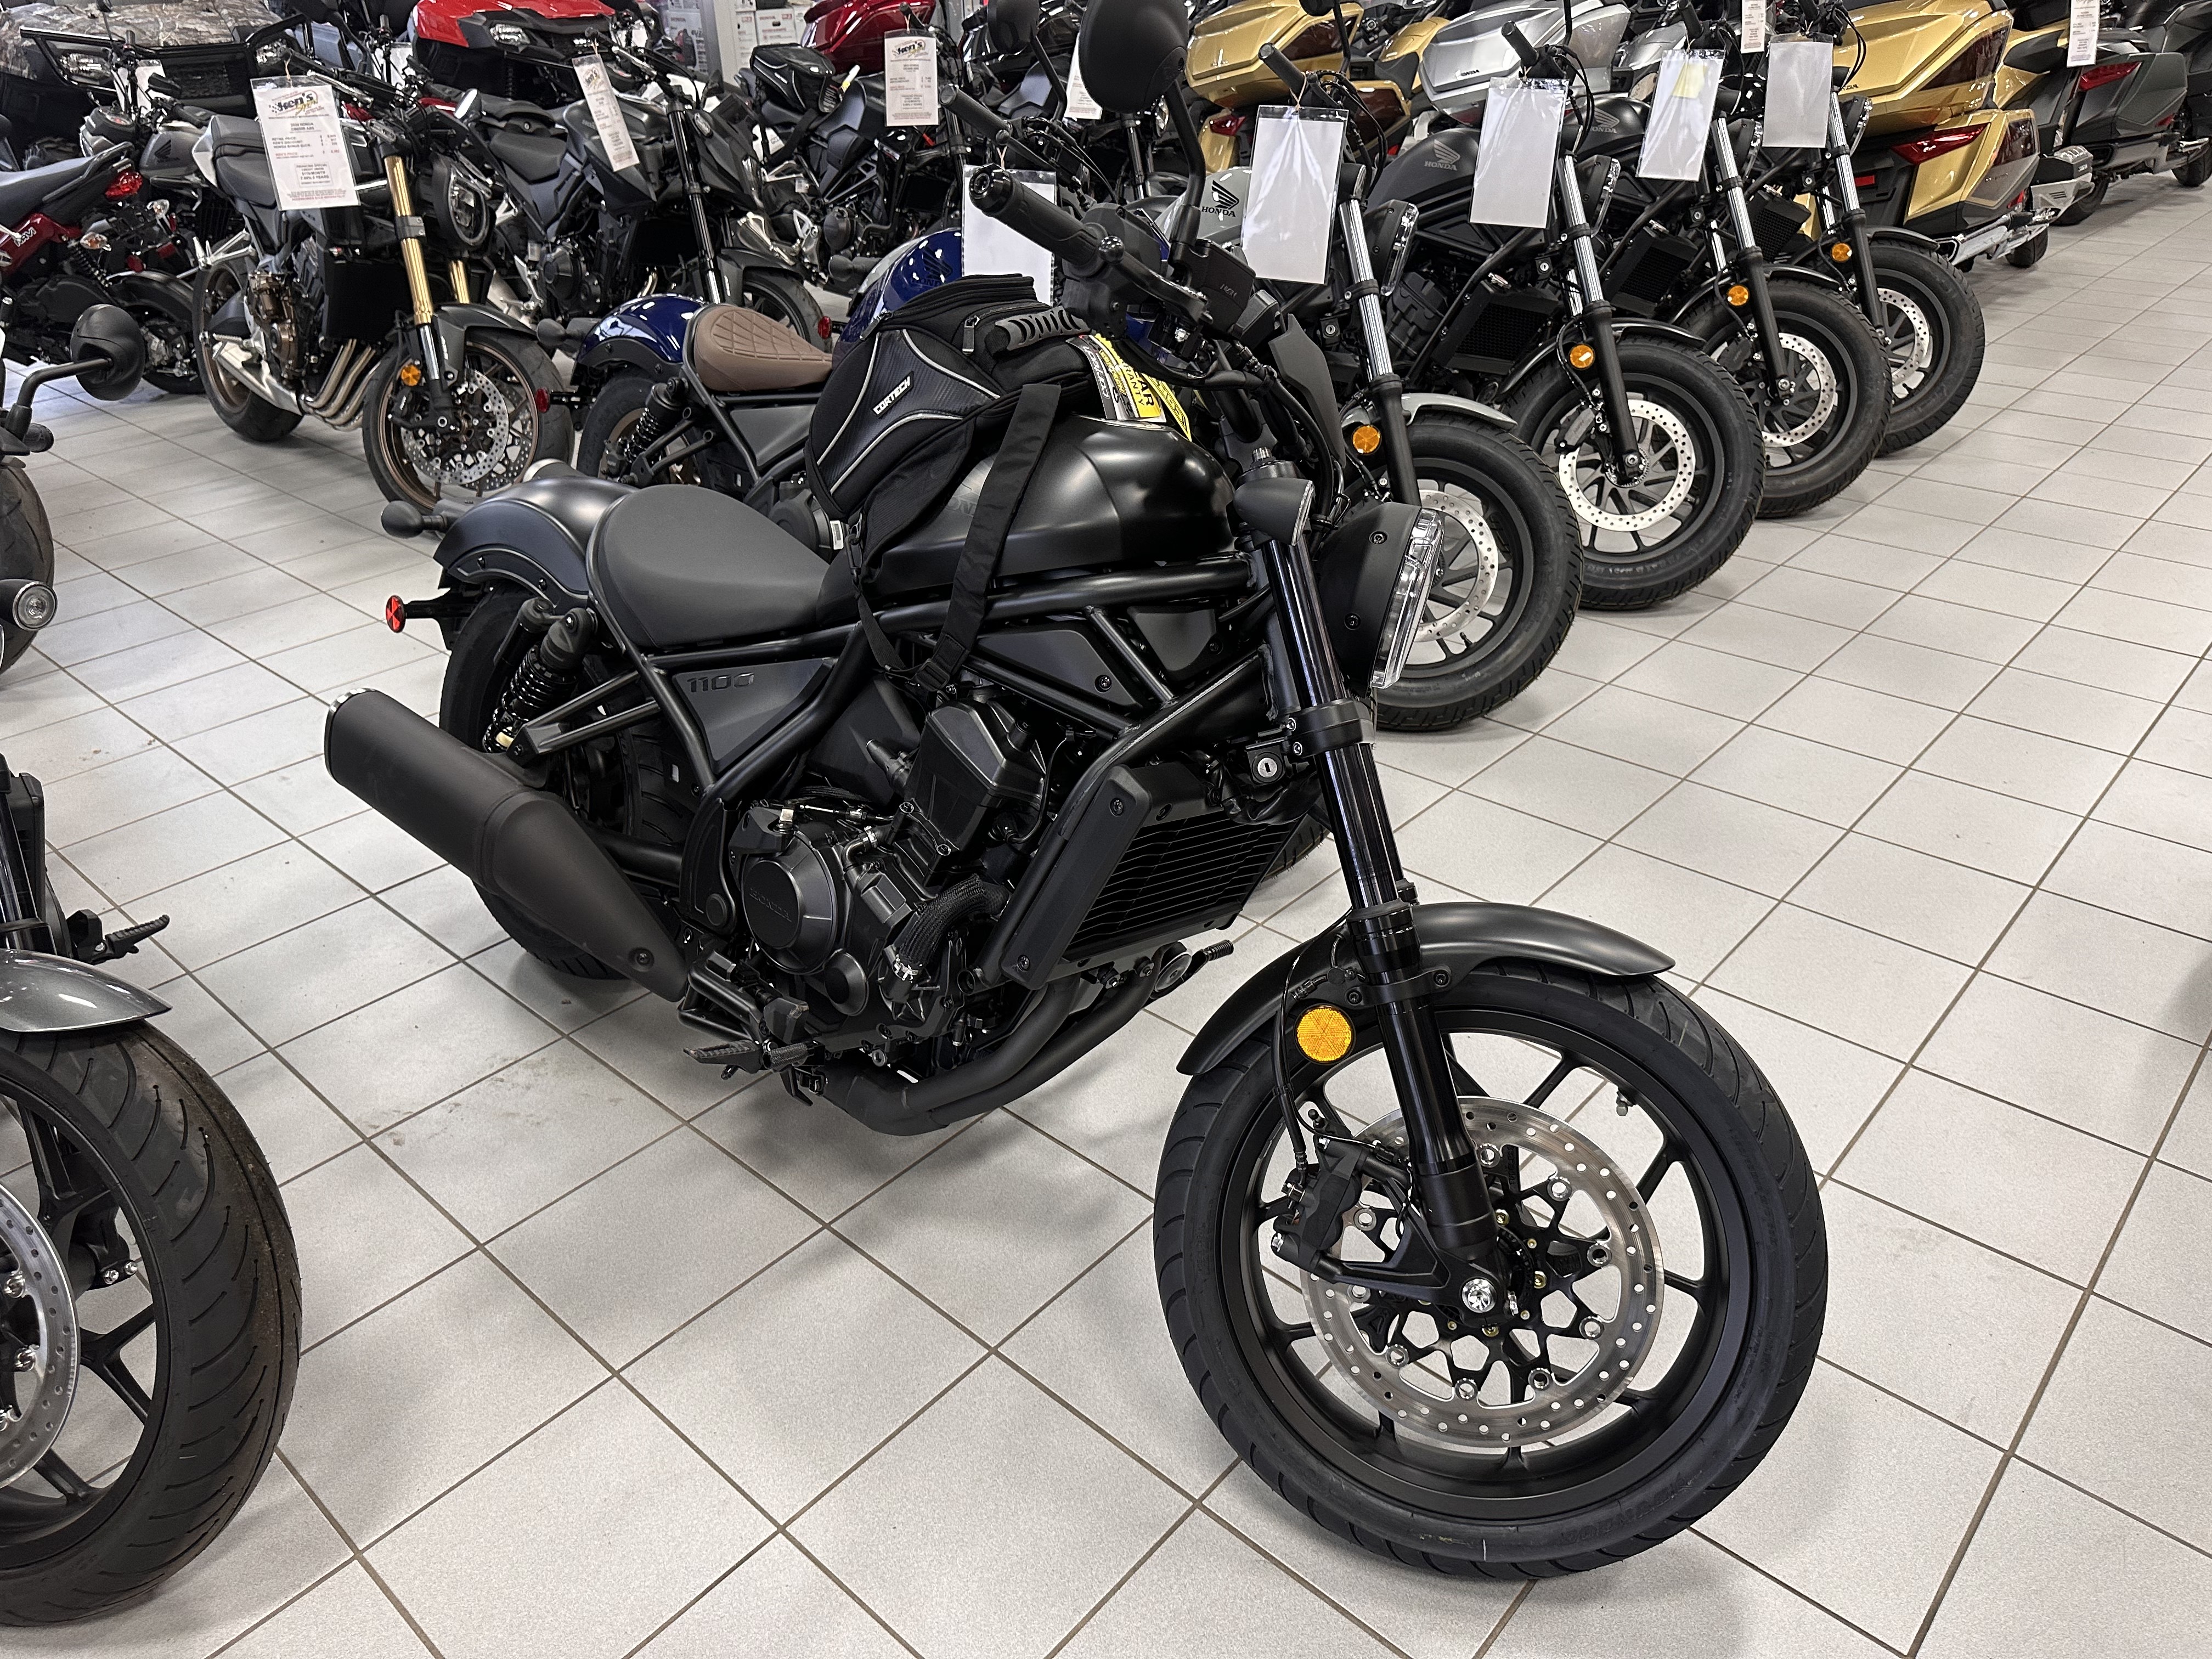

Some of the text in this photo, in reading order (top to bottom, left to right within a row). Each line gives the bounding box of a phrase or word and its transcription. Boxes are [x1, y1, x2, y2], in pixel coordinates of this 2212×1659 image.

[1424, 161, 1457, 171] HONDA
[1201, 206, 1236, 217] HONDA
[873, 376, 910, 415] CORTECH
[686, 672, 754, 692] 1100
